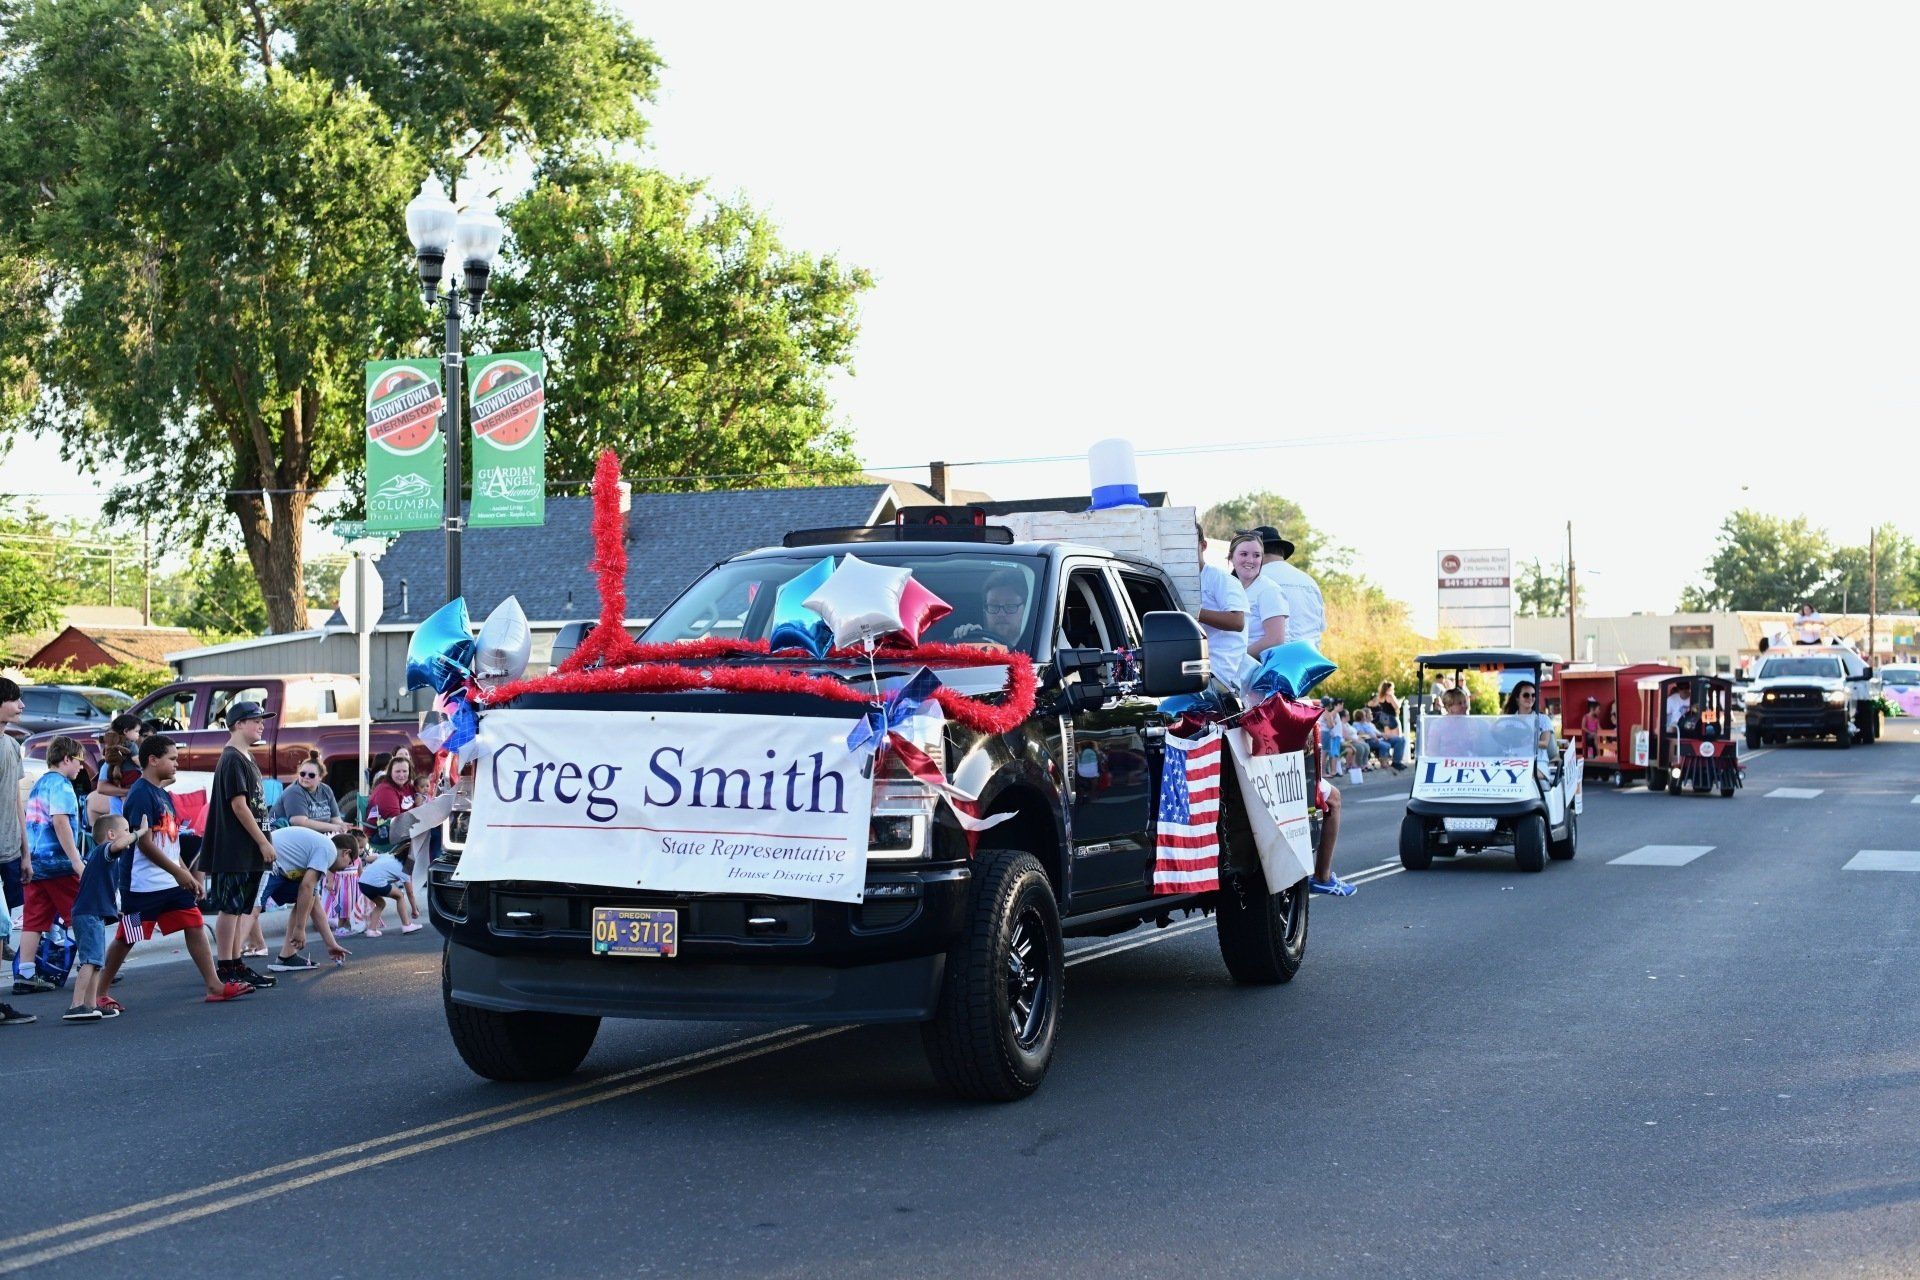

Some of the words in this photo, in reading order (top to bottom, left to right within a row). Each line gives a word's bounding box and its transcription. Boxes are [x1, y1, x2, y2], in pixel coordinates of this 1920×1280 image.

[371, 386, 431, 423] DOWNTOWN
[476, 379, 533, 418] DOWNTOWN
[375, 402, 437, 436] HERMISTON
[481, 395, 538, 432] HERMISTON
[478, 465, 537, 480] GUARDIAN
[370, 498, 440, 511] COLUMBIA
[370, 512, 403, 521] Dental
[408, 510, 440, 520] Clinic
[492, 742, 623, 823] Greg
[643, 746, 849, 815] Smith
[1424, 762, 1527, 784] LEVY
[661, 836, 706, 856] State
[711, 838, 846, 862] Representative
[728, 867, 770, 880] House
[772, 869, 823, 883] District
[826, 872, 846, 884] 57
[618, 912, 651, 920] OREGON
